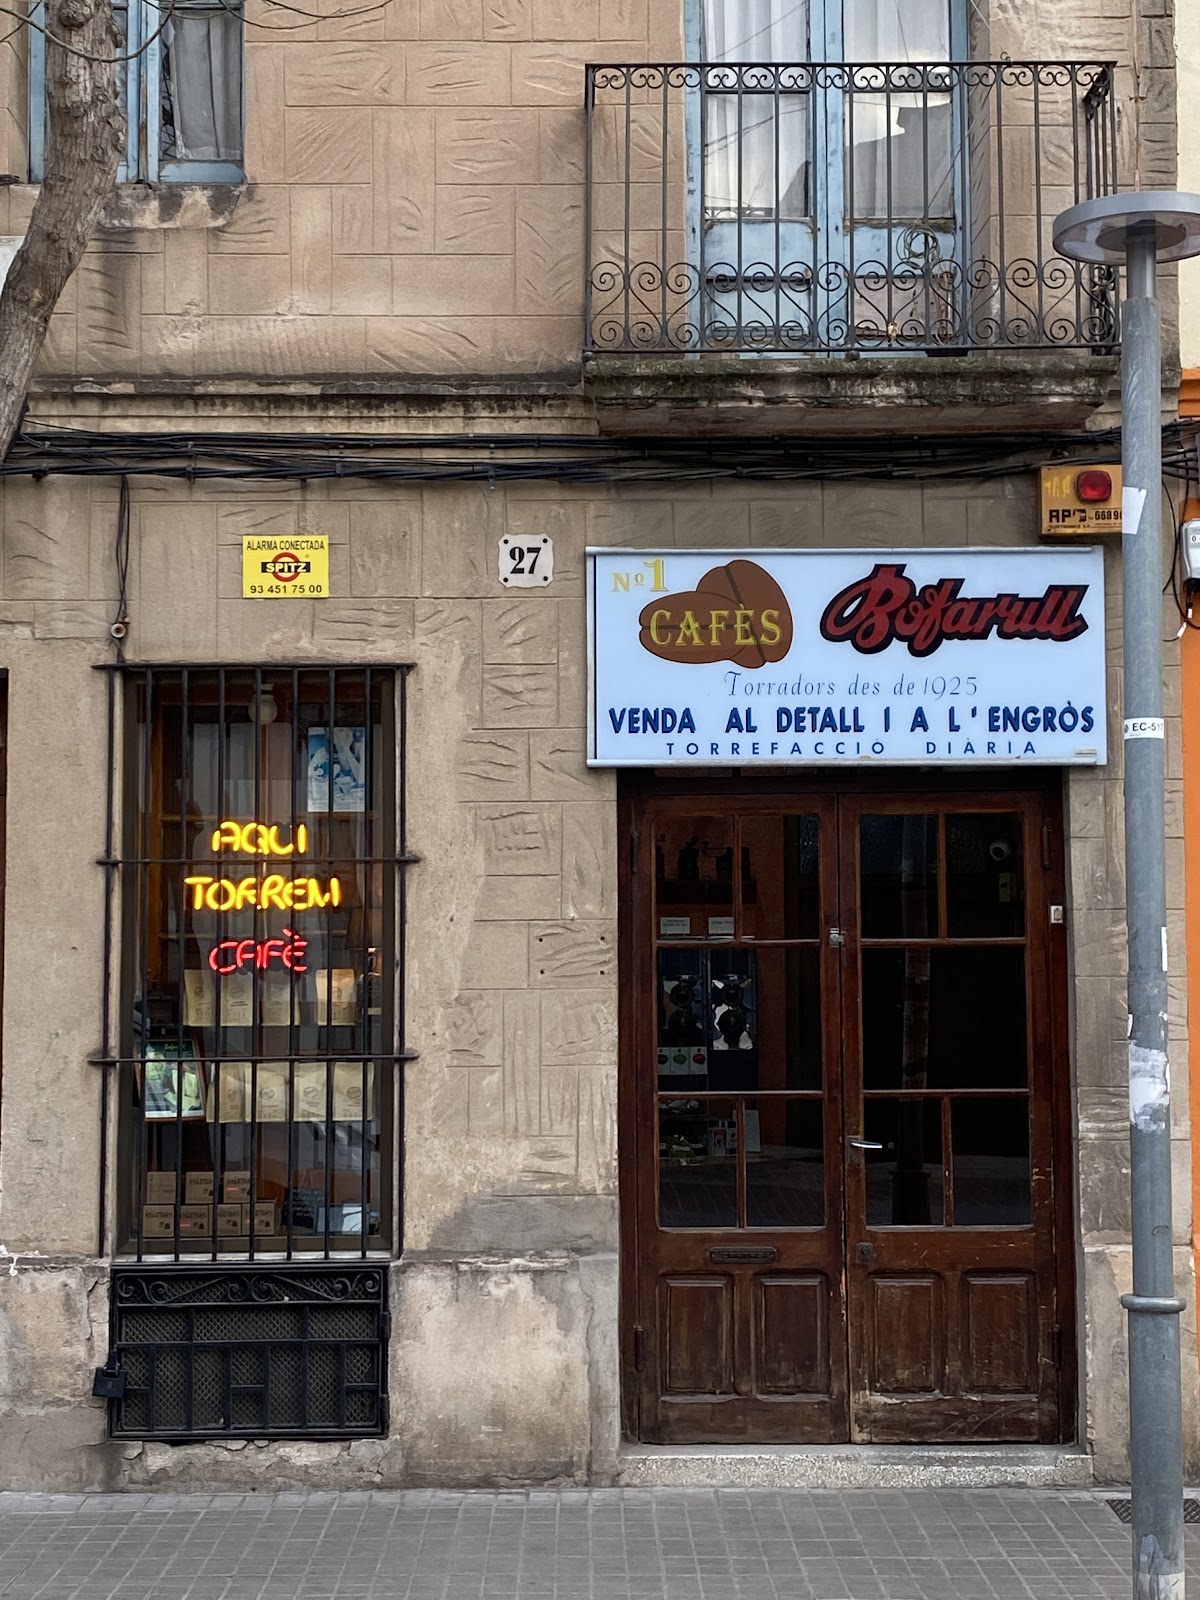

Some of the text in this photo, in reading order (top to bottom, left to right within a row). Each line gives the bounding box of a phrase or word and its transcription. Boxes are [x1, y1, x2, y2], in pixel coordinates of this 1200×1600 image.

[246, 540, 325, 550] ALARMA CONECTADA
[265, 562, 307, 573] SPITZ
[509, 546, 542, 574] 27
[250, 585, 322, 594] 93 451 75 00
[819, 564, 1090, 657] Bofarull
[724, 671, 978, 700] Torradors des de 1925
[608, 708, 696, 735] VENDA
[725, 706, 757, 734] AL
[776, 707, 866, 734] DETALL
[884, 707, 891, 733] I
[910, 707, 928, 734] A
[211, 821, 309, 856] AQUI
